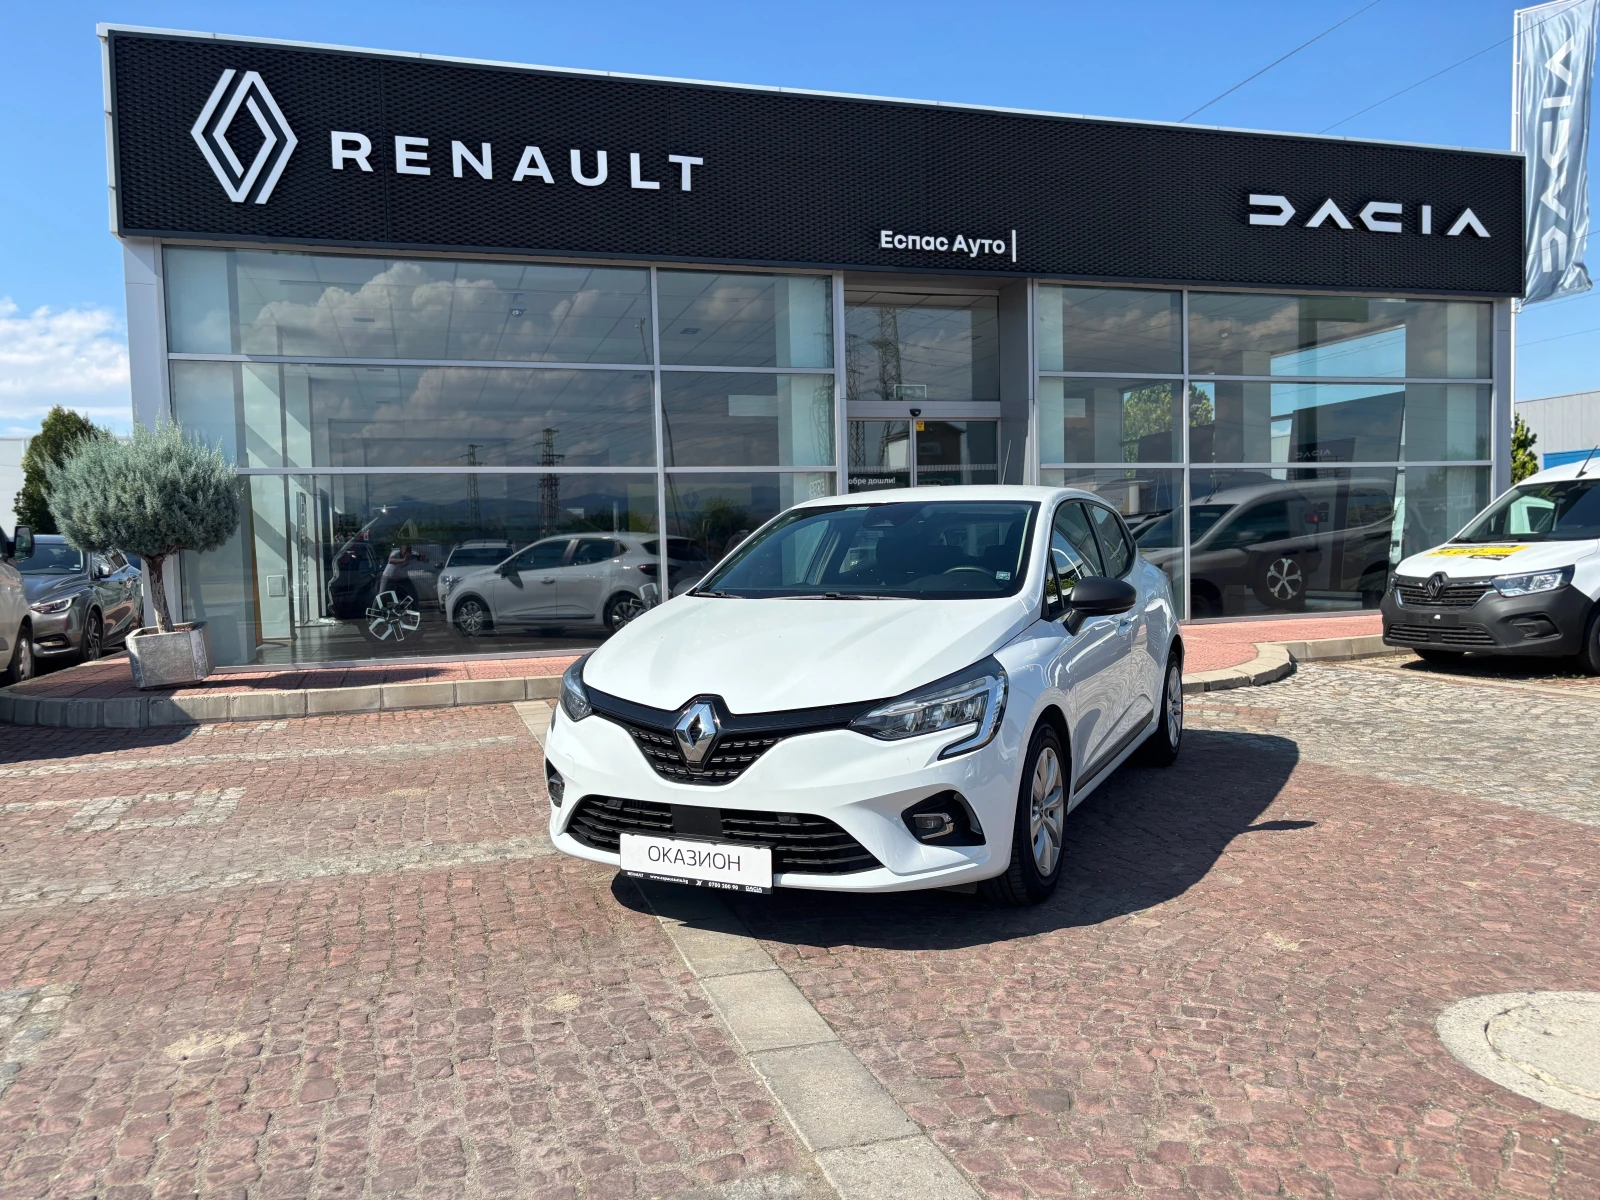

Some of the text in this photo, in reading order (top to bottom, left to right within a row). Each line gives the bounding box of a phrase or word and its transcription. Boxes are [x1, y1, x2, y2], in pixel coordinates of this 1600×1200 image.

[330, 130, 704, 192] RENAULT
[1540, 35, 1575, 273] DACIA
[1248, 193, 1491, 238] DACIA
[880, 230, 1006, 258] Еспас Ауто
[848, 477, 896, 485] обре дошли!
[648, 845, 740, 871] ОКАЗИОН
